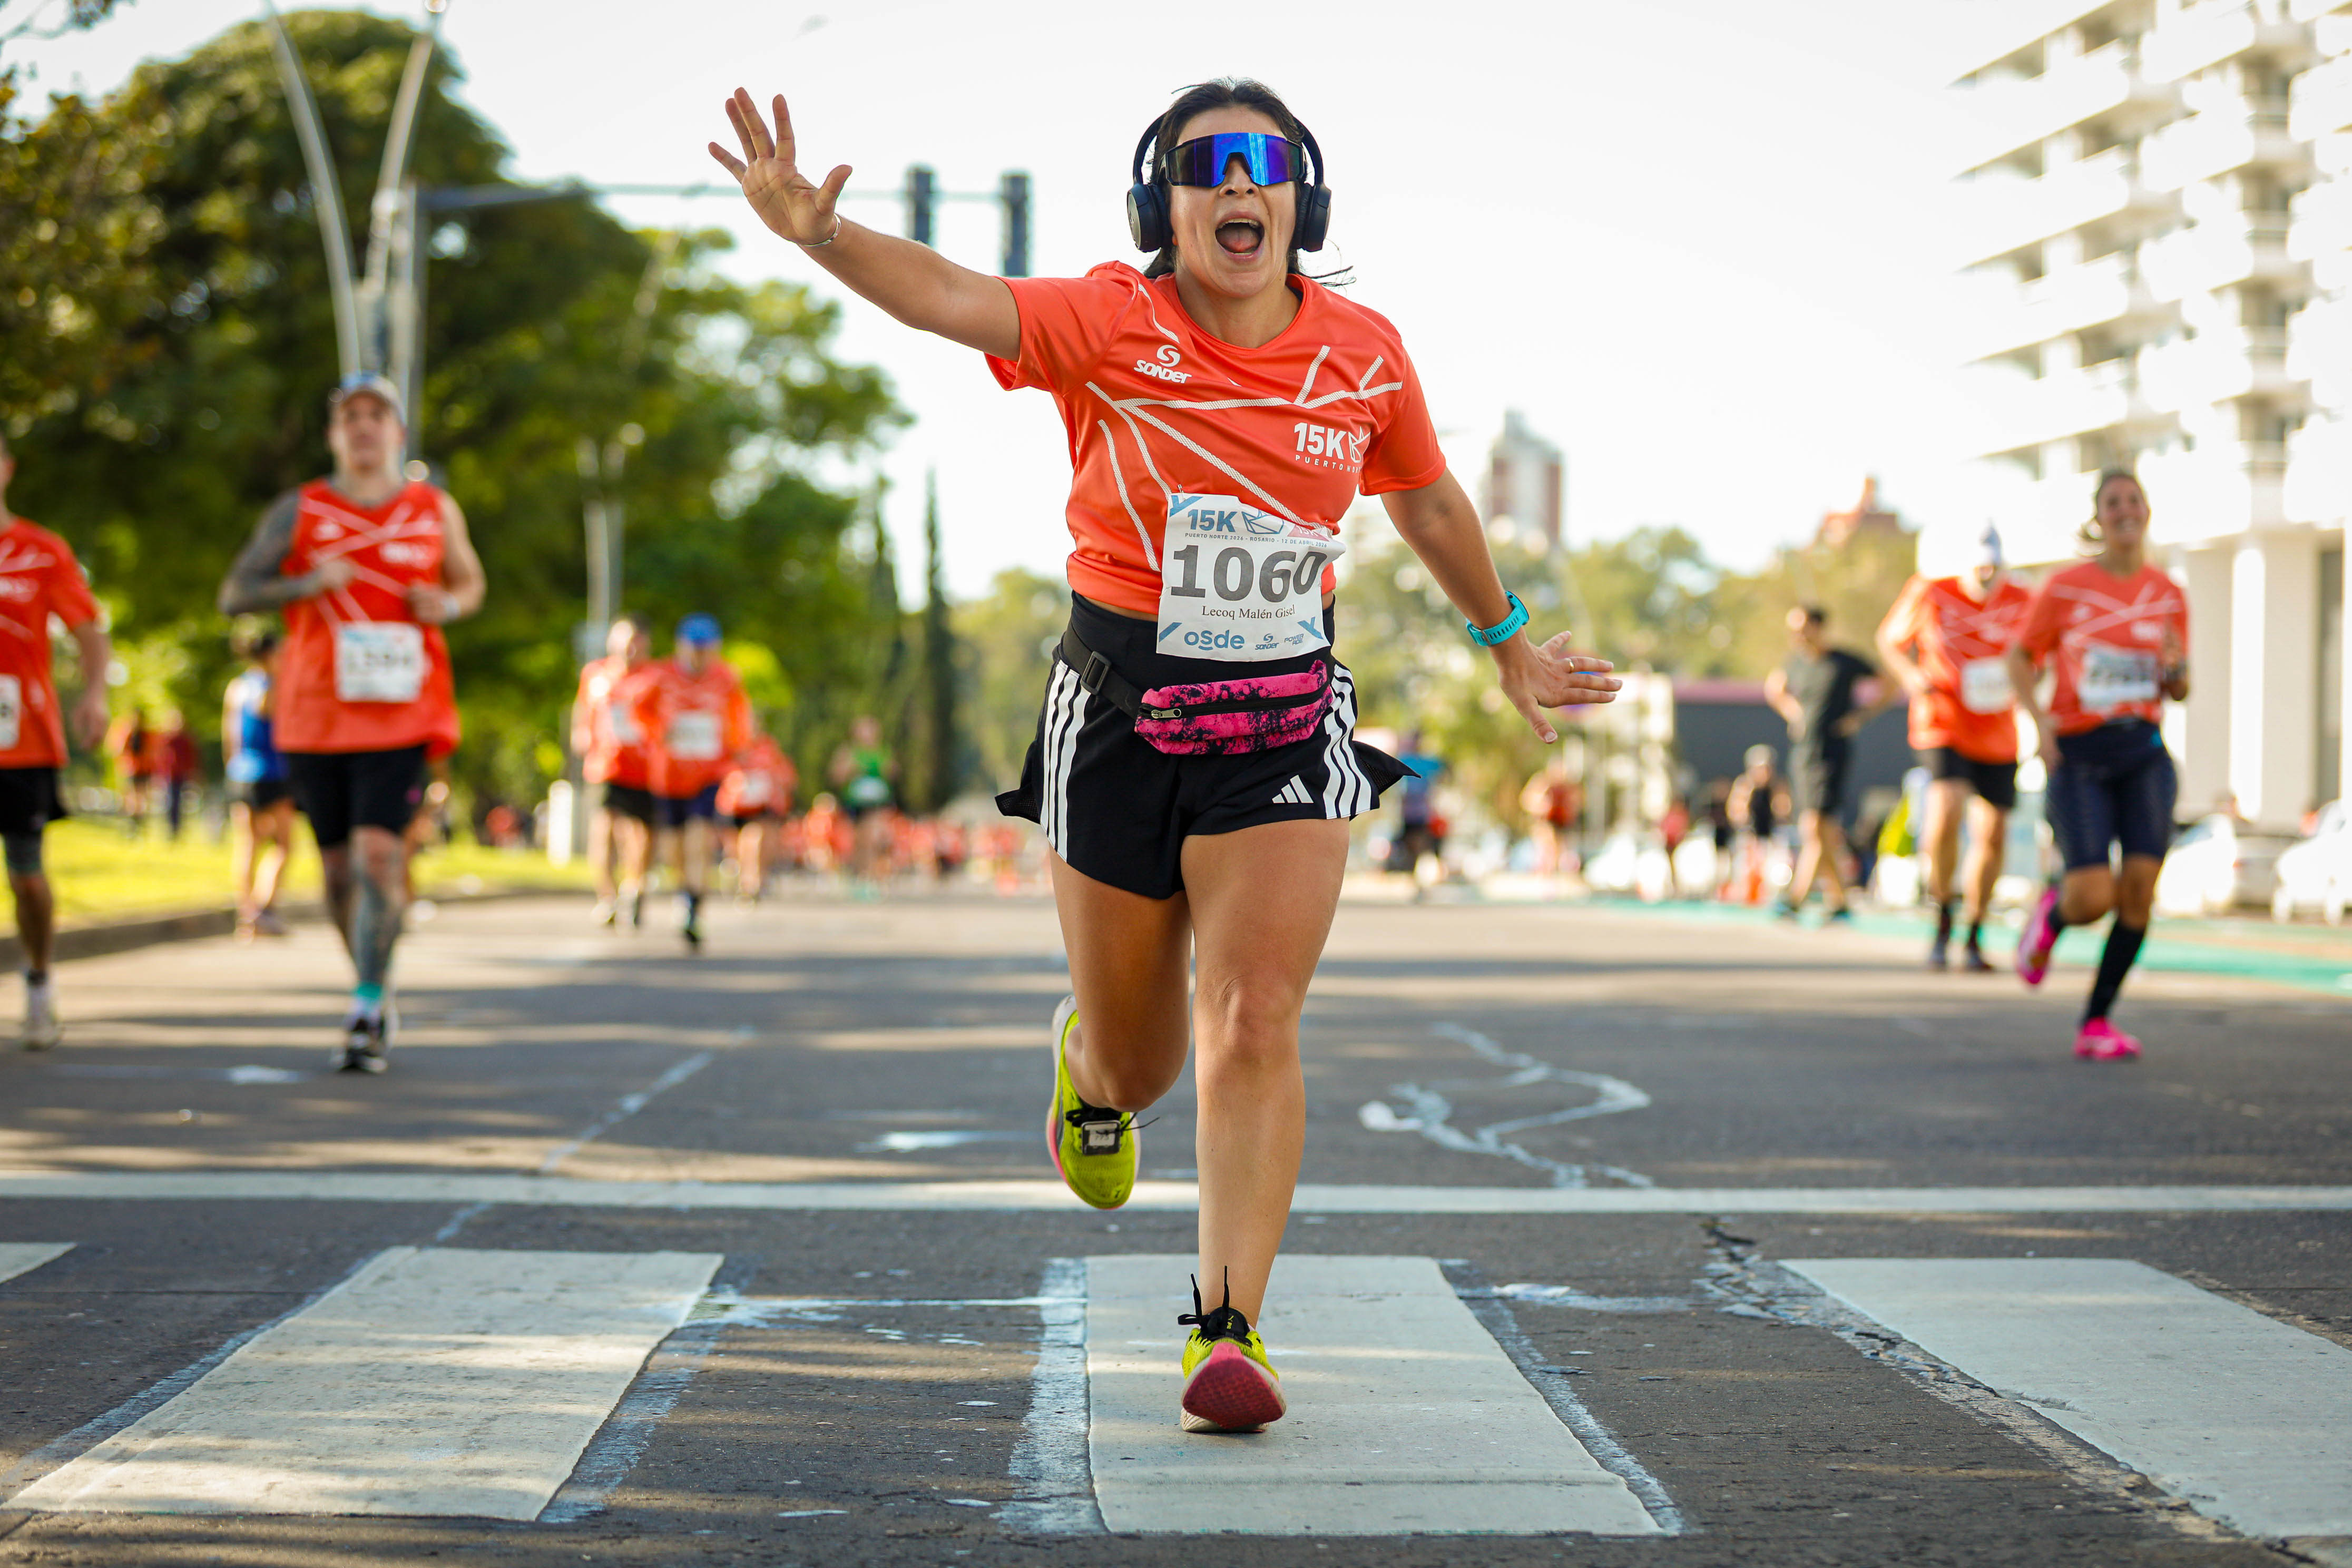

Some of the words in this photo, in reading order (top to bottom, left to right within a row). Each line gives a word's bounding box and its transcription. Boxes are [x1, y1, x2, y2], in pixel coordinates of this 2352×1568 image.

[1294, 423, 1347, 459] 15K
[1296, 455, 1344, 471] PUERTO
[1188, 509, 1238, 532] 15K
[1171, 545, 1327, 603] 1060
[1201, 605, 1235, 620] Lecoq
[1239, 609, 1272, 619] Malén
[1276, 604, 1296, 618] Gisel
[1184, 630, 1245, 650] osde
[1284, 633, 1304, 643] POWER
